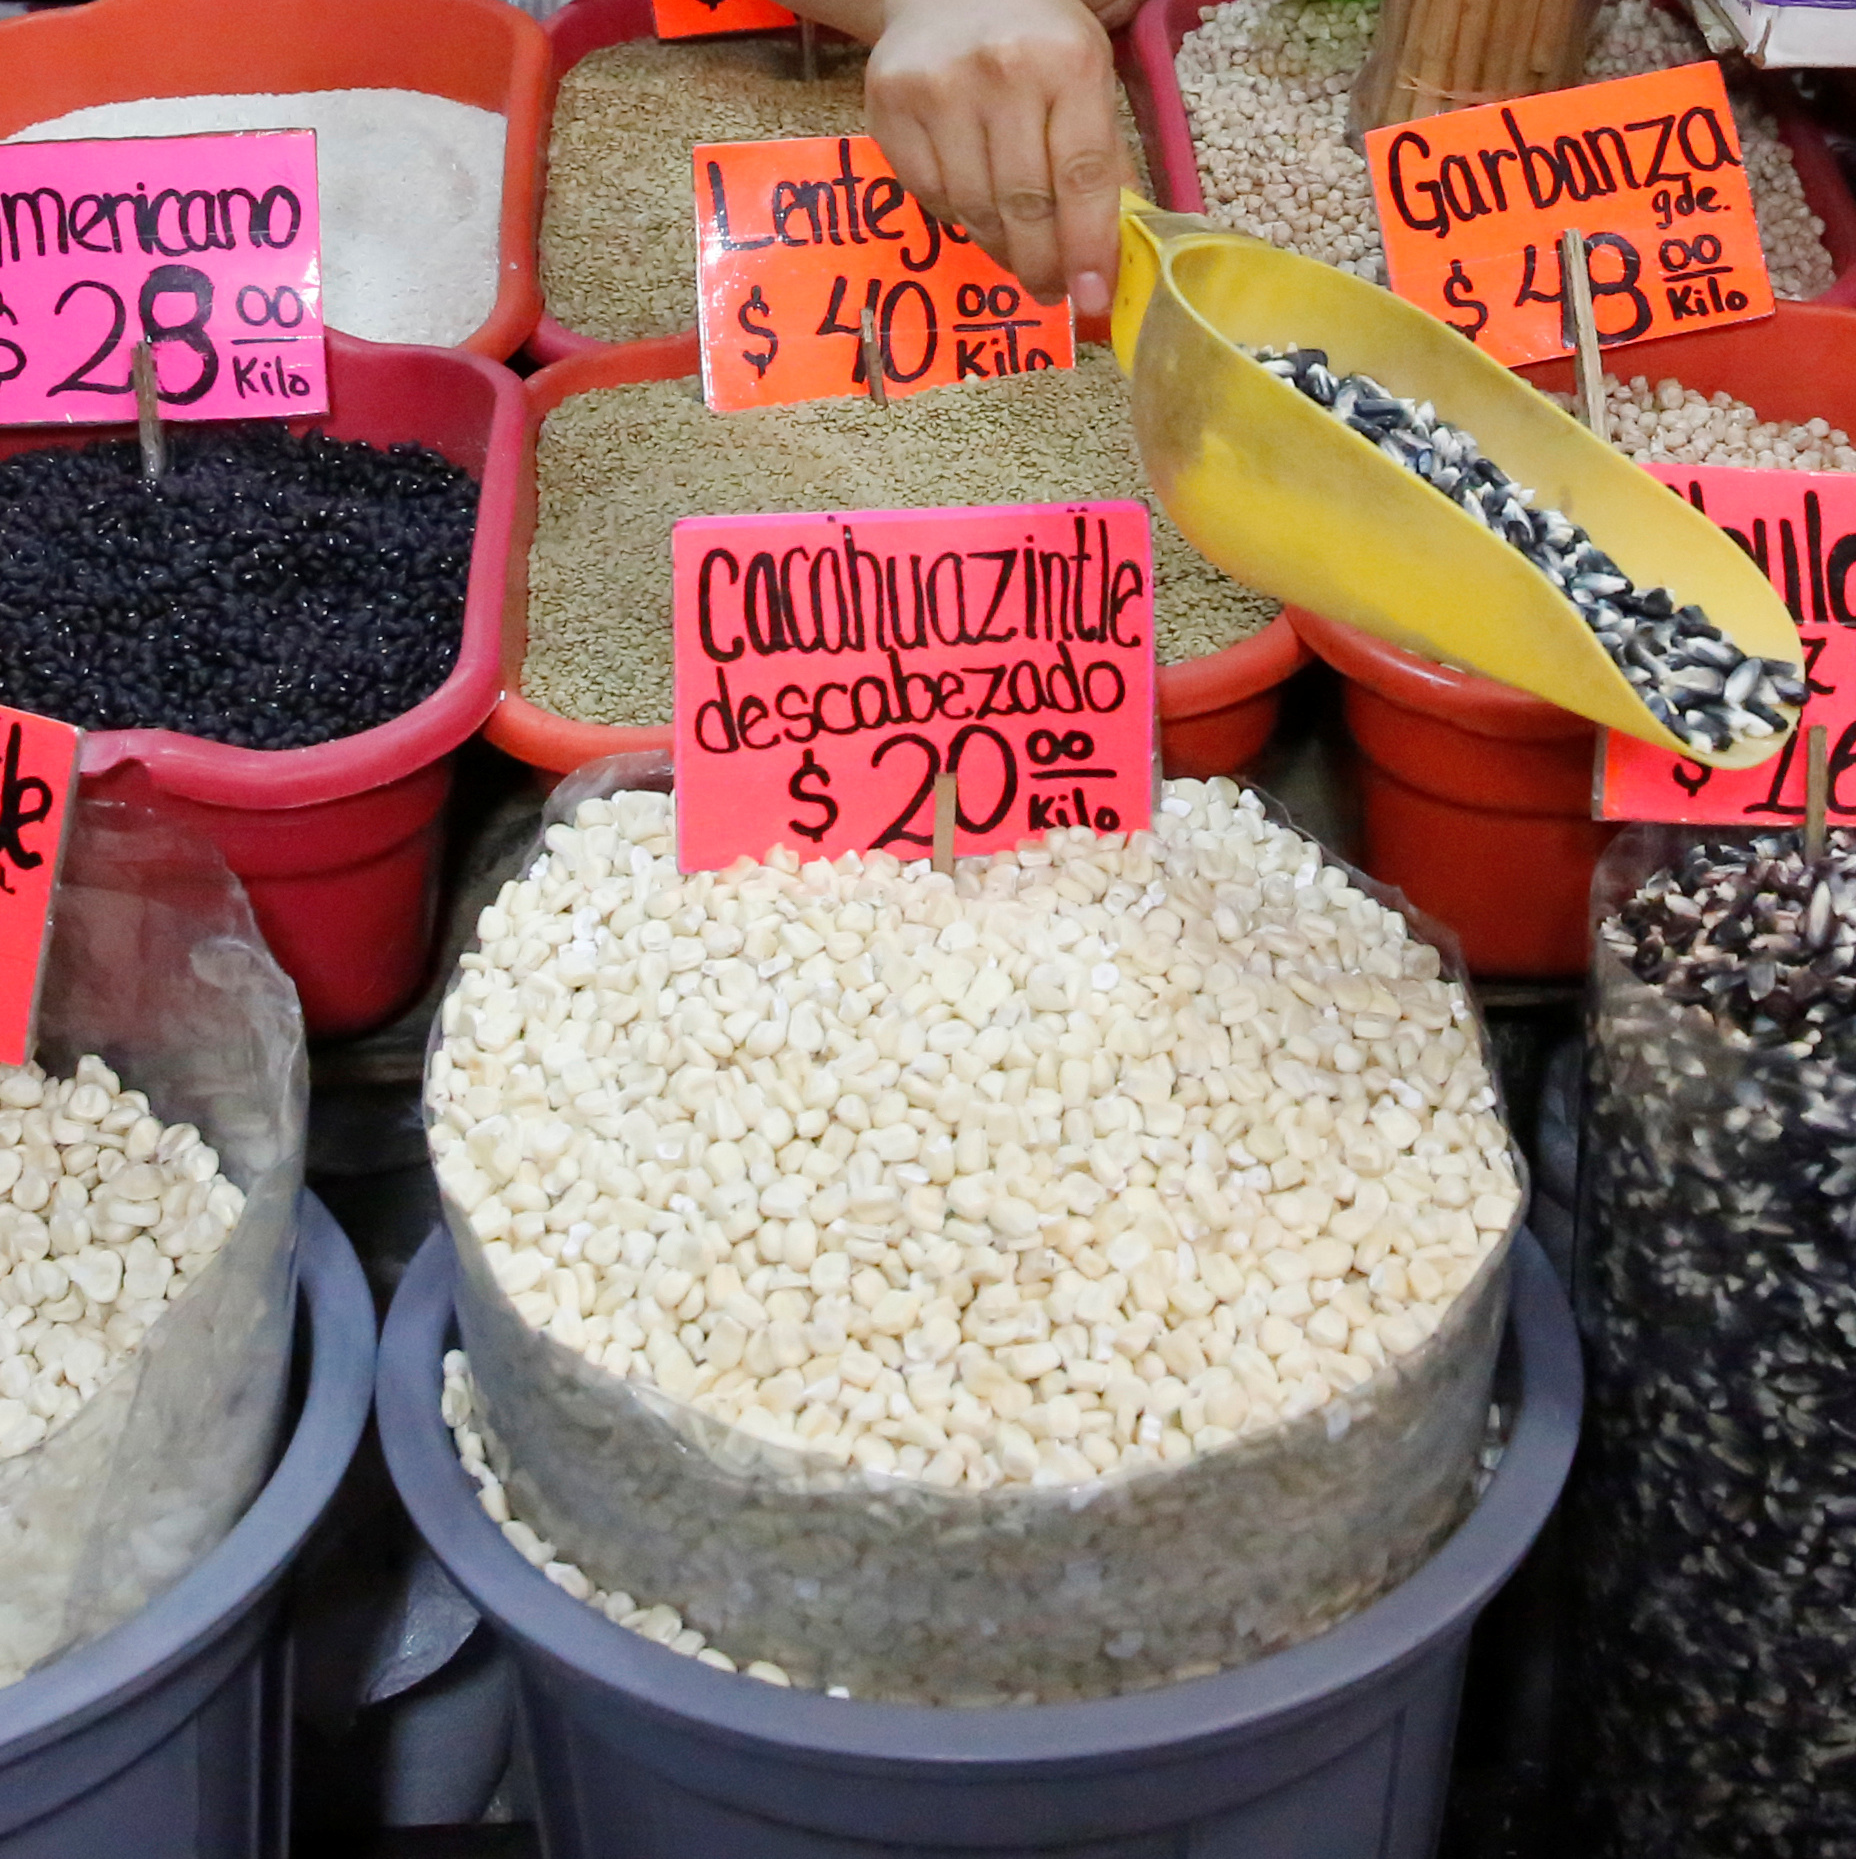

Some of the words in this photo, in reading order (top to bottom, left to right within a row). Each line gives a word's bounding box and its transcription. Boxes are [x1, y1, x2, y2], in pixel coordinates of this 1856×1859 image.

[1387, 106, 1744, 239] Garbanza
[46, 263, 221, 406] 28
[235, 283, 305, 328] 00
[737, 285, 779, 379] $
[815, 275, 940, 385] 40
[956, 282, 1022, 319] 00
[1443, 258, 1489, 343] $
[1658, 232, 1723, 272] 00
[1666, 276, 1749, 322] Kilo
[233, 355, 311, 400] Kilo
[694, 640, 1128, 755] descabezado
[866, 724, 1019, 852] 20
[1025, 729, 1096, 766] 00
[1029, 787, 1121, 832] Kilo
